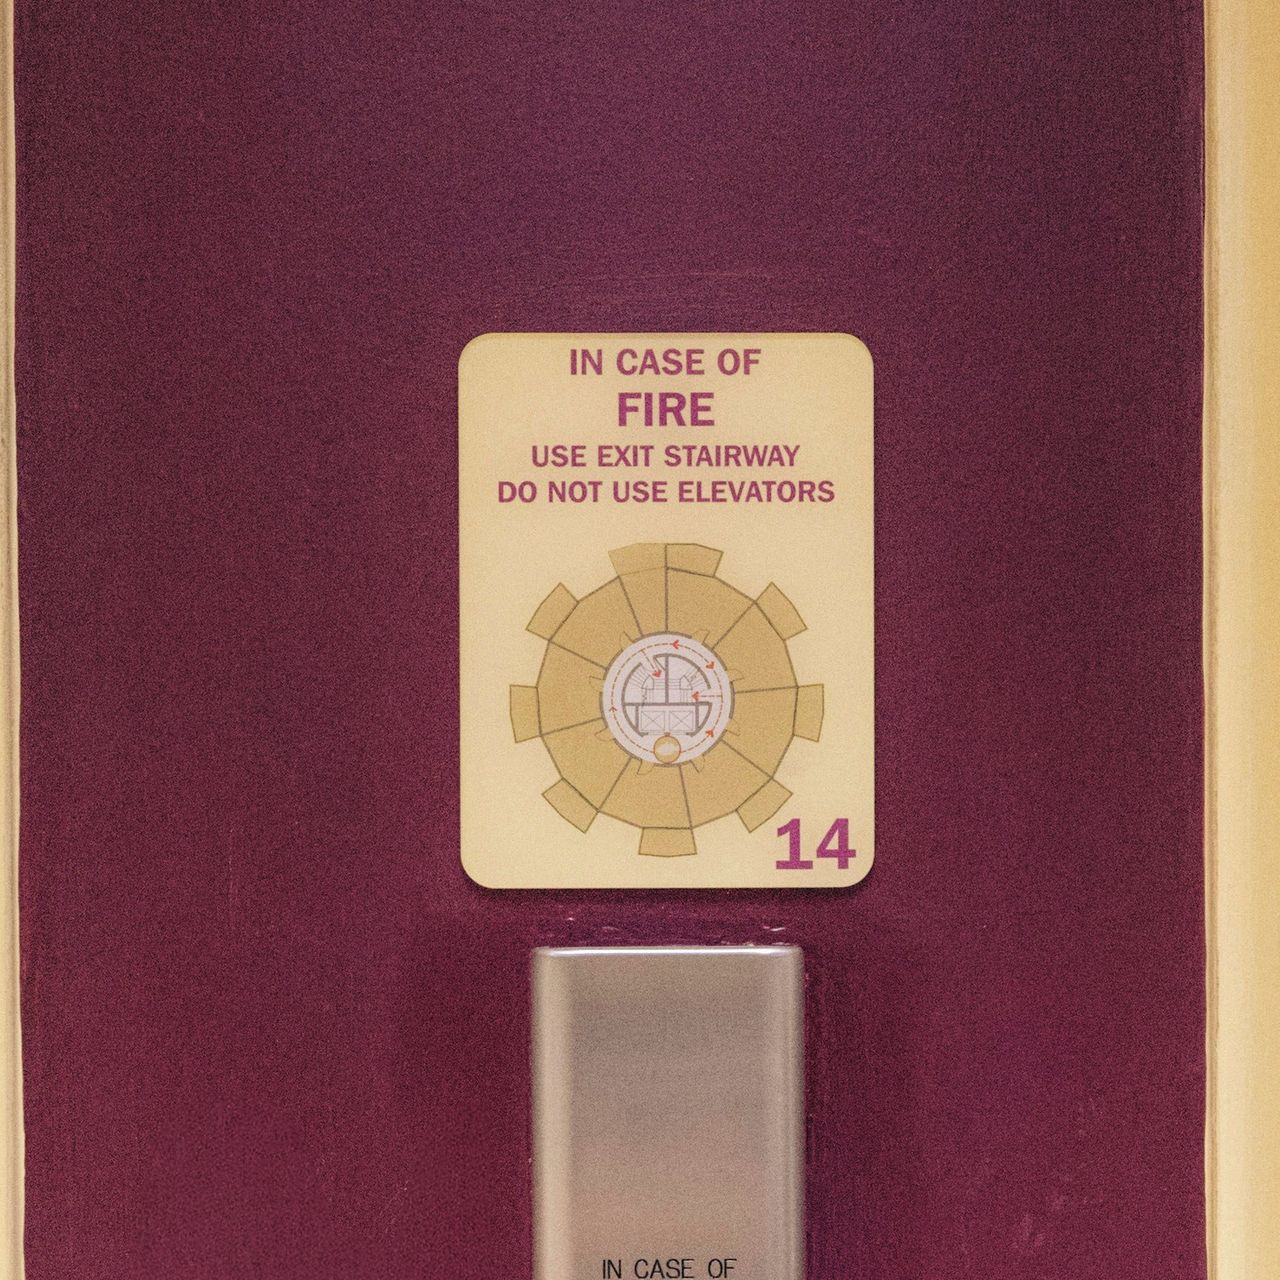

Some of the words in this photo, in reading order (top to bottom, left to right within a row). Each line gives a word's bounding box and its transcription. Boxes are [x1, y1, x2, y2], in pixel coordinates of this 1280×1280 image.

[569, 348, 603, 376] IN
[616, 348, 706, 376] CASE
[717, 348, 761, 376] OF
[618, 391, 716, 427] FIRE
[531, 444, 587, 468] USE
[598, 444, 655, 468] EXIT
[664, 444, 801, 468] STAIRWAY
[497, 480, 538, 503] DO
[548, 480, 604, 503] NOT
[613, 480, 668, 503] USE
[678, 480, 836, 503] ELEVATORS
[775, 817, 857, 870] 14
[602, 1258, 622, 1279] IN
[634, 1258, 695, 1279] CASE
[707, 1258, 738, 1279] OF
